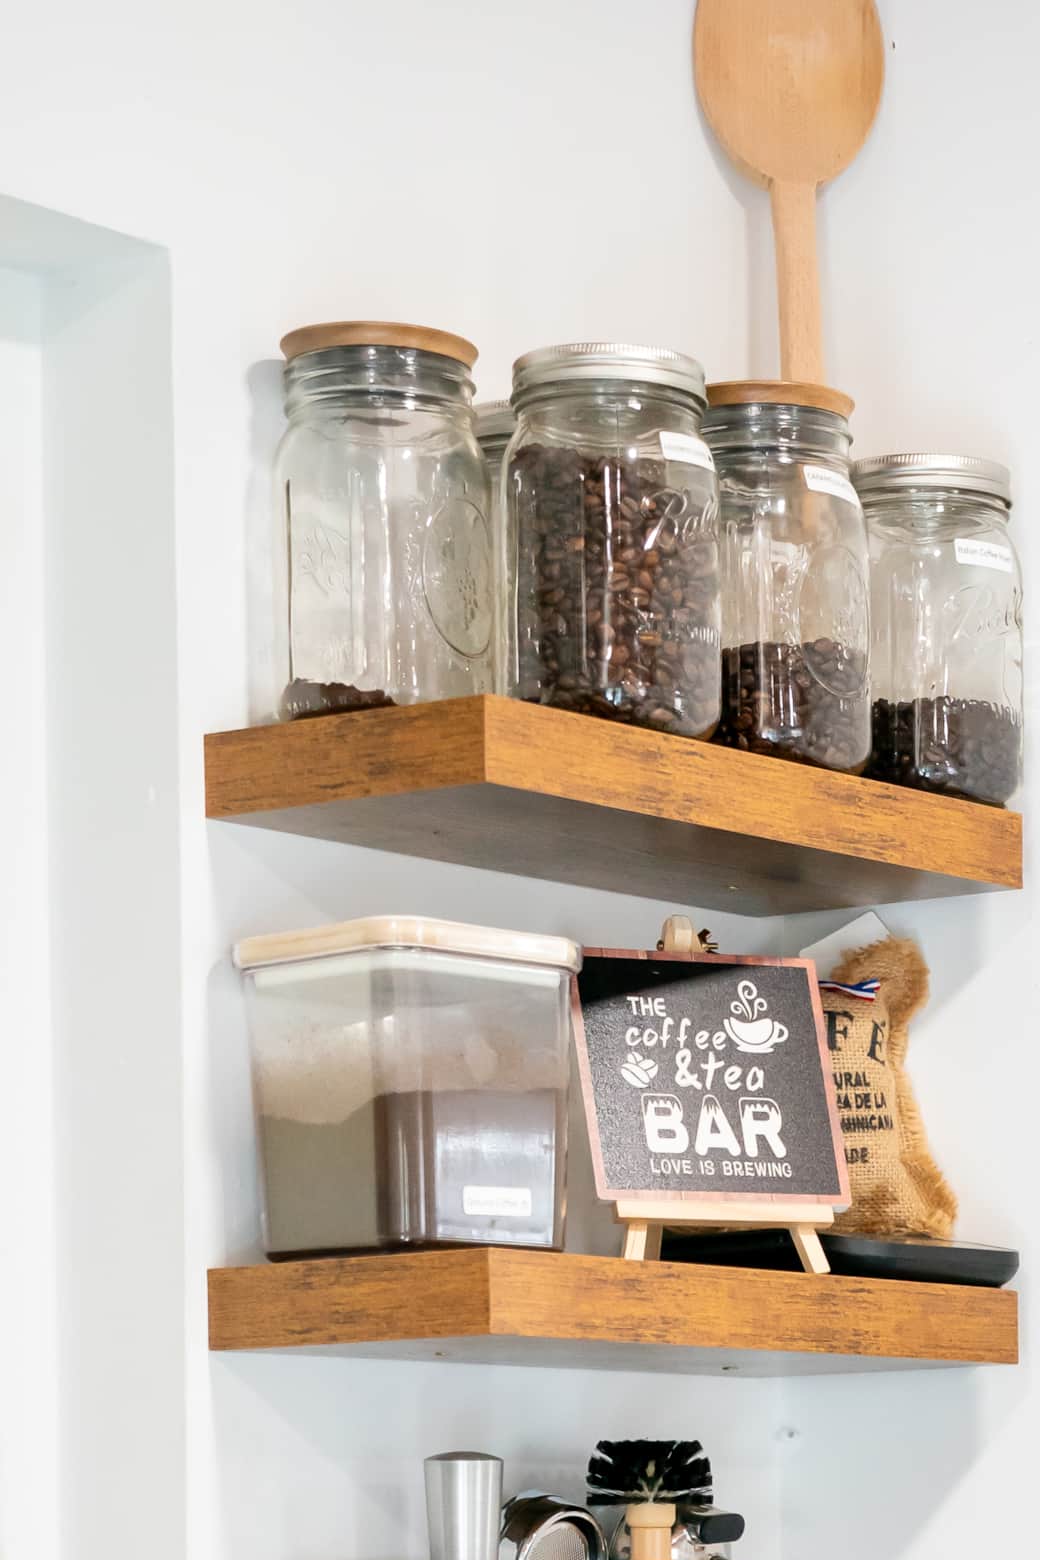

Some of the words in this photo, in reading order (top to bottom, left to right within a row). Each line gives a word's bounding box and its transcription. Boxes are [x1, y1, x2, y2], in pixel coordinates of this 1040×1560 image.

[626, 996, 667, 1017] THE
[625, 1017, 728, 1051] coffee
[674, 1049, 765, 1092] &tea
[641, 1093, 788, 1158] BAR
[650, 1158, 692, 1176] LOVE
[700, 1160, 715, 1176] IS
[722, 1160, 793, 1179] BREWING
